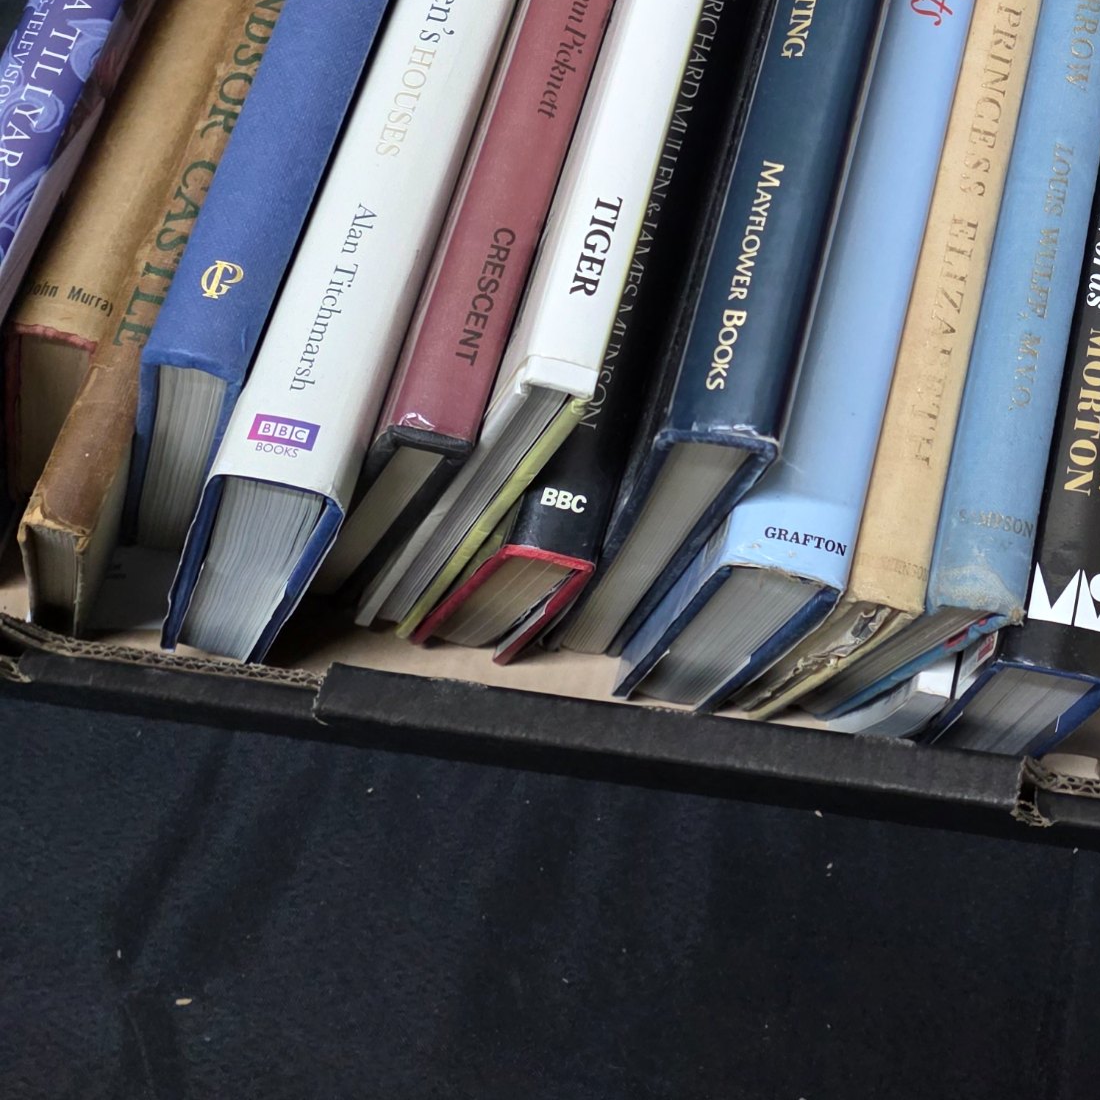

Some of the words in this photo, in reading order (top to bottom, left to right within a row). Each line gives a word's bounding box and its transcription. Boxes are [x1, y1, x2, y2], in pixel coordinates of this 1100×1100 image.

[0, 28, 82, 196] TILLYARD
[376, 45, 436, 158] HOUSES
[538, 24, 587, 119] Picknett
[960, 2, 1024, 197] PRINCESS
[342, 203, 377, 254] Alan
[569, 196, 623, 297] TIGER
[727, 160, 785, 301] MAYFLOWER
[290, 262, 359, 392] Titchmarsh
[455, 228, 516, 366] CRESCENT
[705, 309, 748, 391] BOOKS
[255, 442, 299, 459] BOOKS
[260, 422, 307, 442] BBC
[540, 487, 587, 514] BBC
[764, 526, 848, 557] GRAFTON
